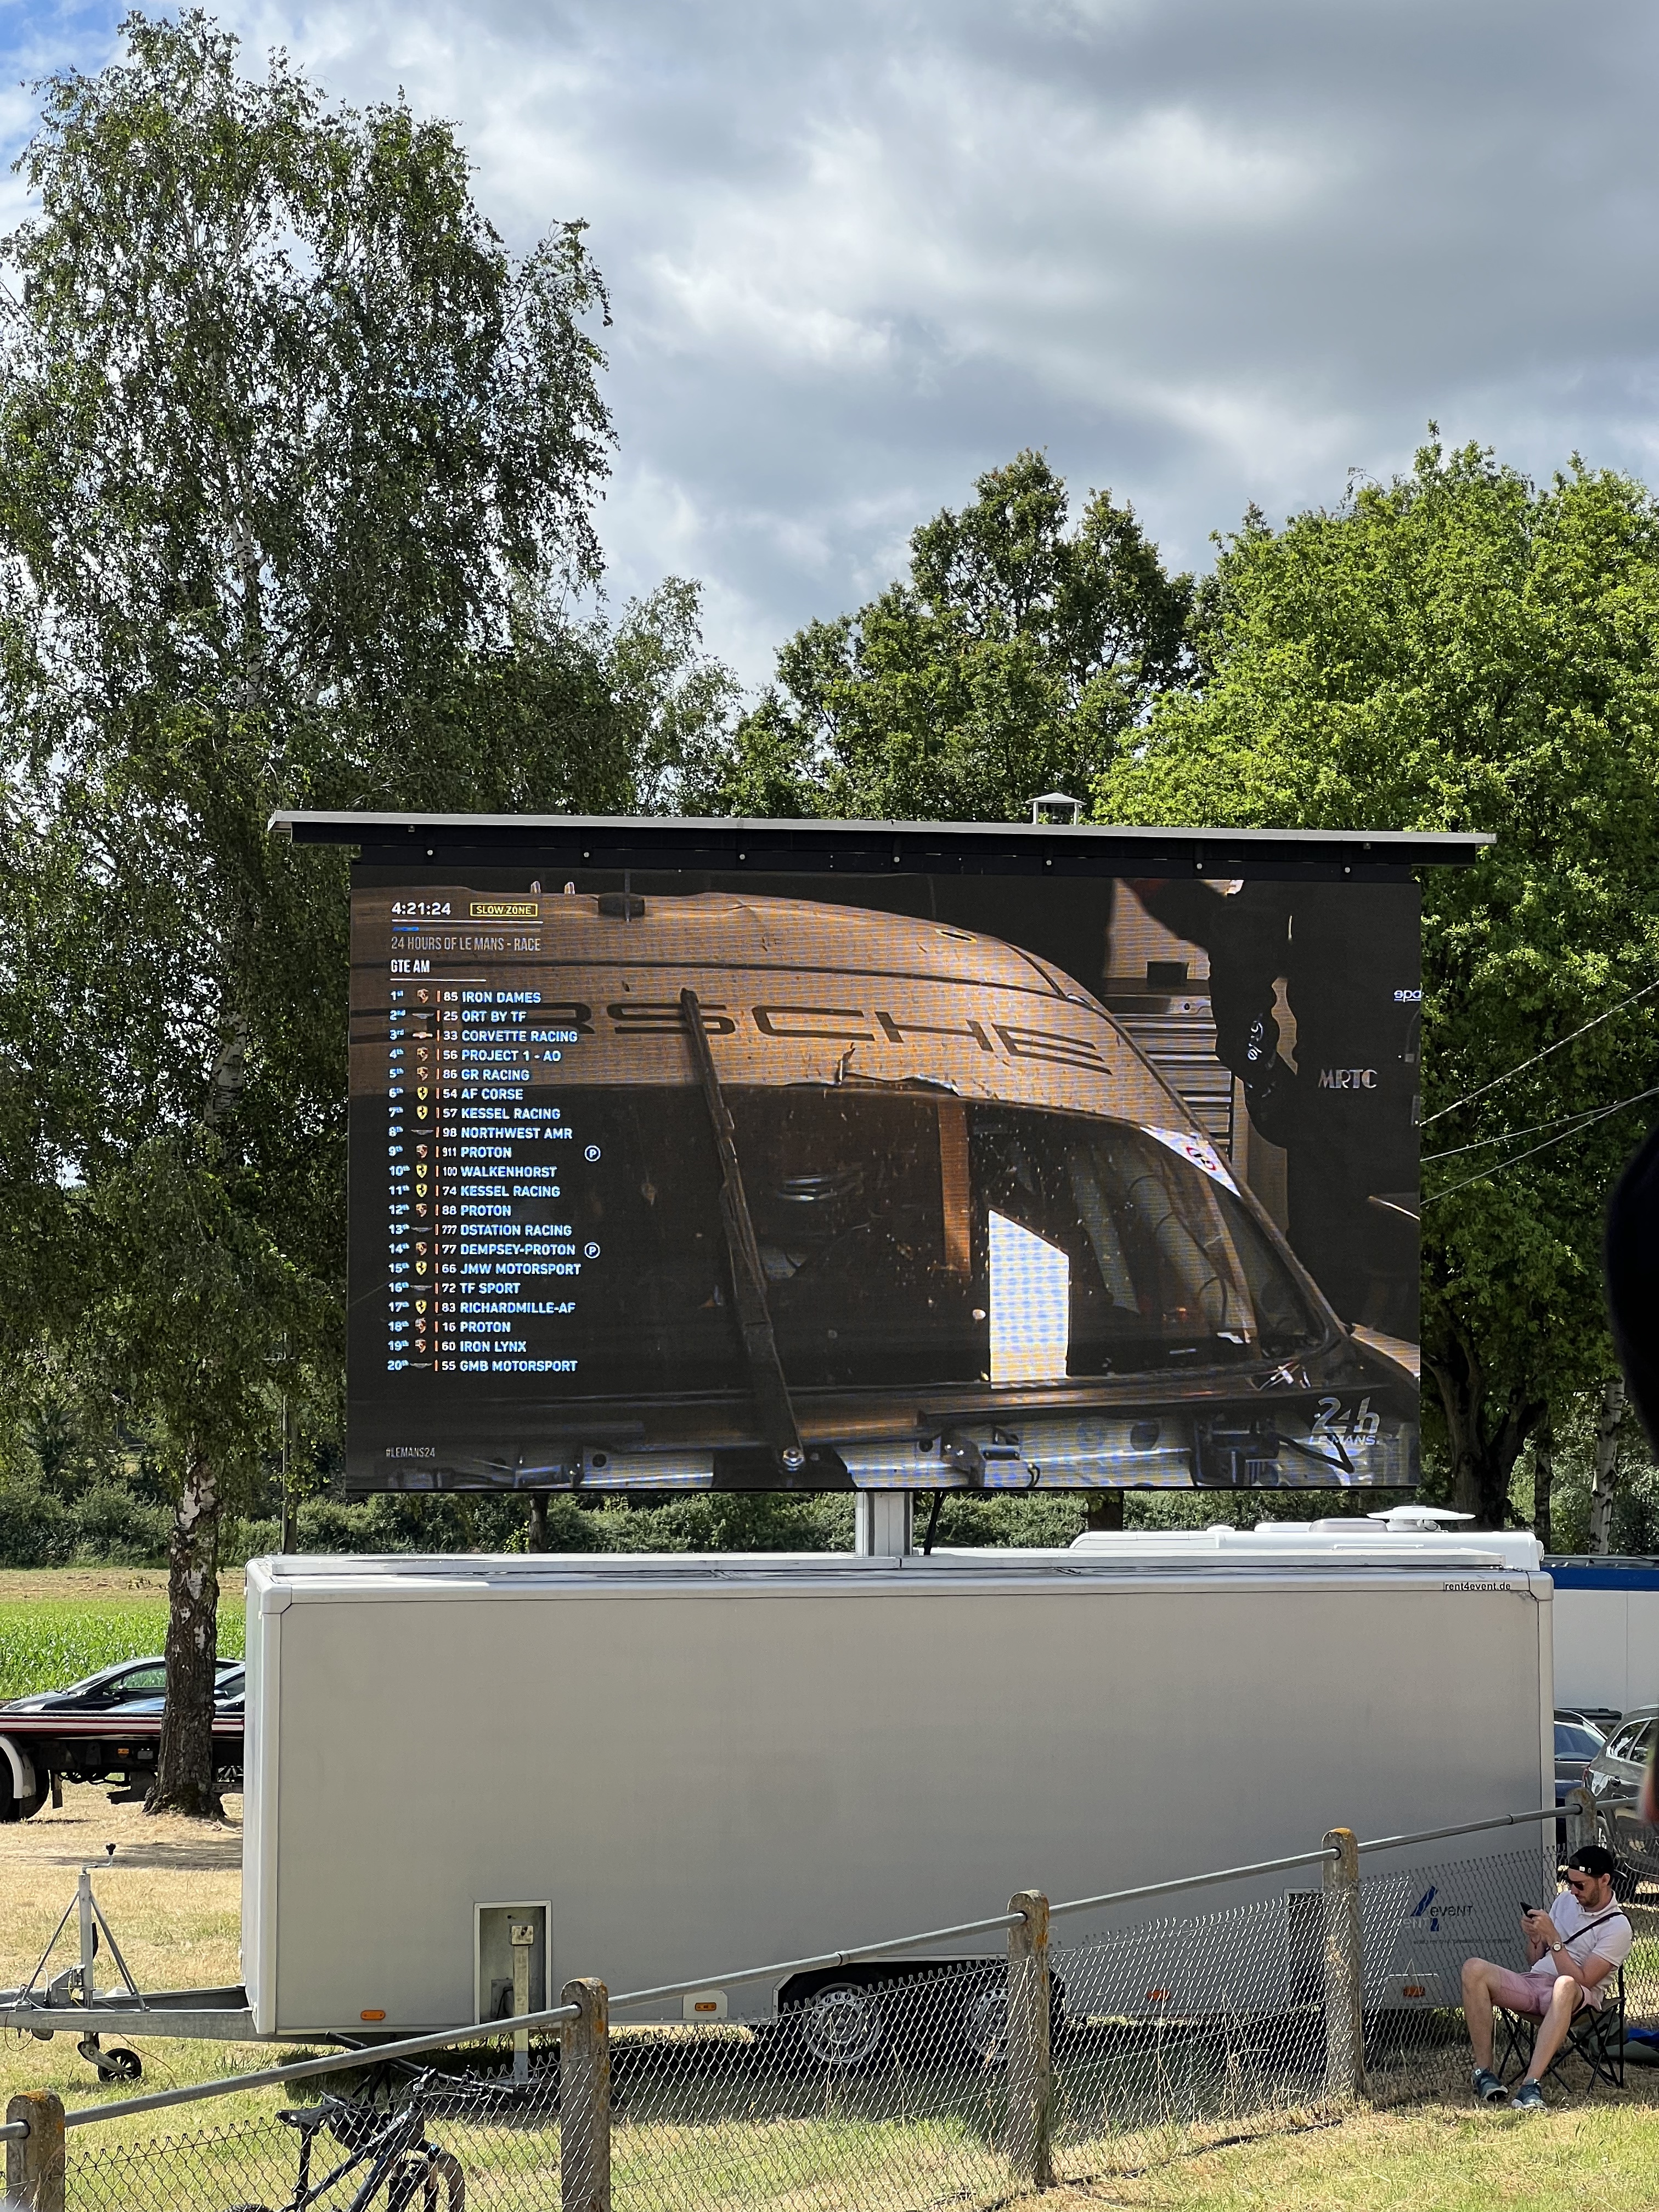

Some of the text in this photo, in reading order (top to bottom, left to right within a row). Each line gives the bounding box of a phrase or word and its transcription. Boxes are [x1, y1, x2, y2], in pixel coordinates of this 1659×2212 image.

[392, 902, 451, 915] 4:21:24
[476, 905, 532, 915] SLOW ZONE
[391, 936, 404, 950] 24
[408, 936, 442, 951] HOURS
[444, 937, 458, 951] OF
[460, 937, 472, 951] LE
[474, 938, 504, 951] MANS
[514, 938, 541, 952] RACE
[390, 959, 430, 973] GTE AM
[443, 991, 459, 1001] 85
[462, 991, 493, 1003] IRON
[496, 991, 541, 1003] DAMES
[443, 1011, 458, 1021] 25
[461, 1010, 487, 1022] ORT
[490, 1010, 507, 1023] BY
[510, 1011, 527, 1022] TF
[443, 1030, 458, 1041] 33
[461, 1030, 527, 1042] CORVETTE
[530, 1030, 578, 1043] RACING
[443, 1049, 458, 1060] 56
[461, 1049, 519, 1061] PROJECT
[523, 1050, 530, 1061] 1
[543, 1050, 561, 1062] AO
[442, 1069, 458, 1079] 86
[461, 1068, 479, 1080] GR
[482, 1069, 530, 1081] RACING
[1317, 1068, 1378, 1089] MRTC
[443, 1088, 458, 1099] 54
[461, 1088, 478, 1099] AF
[481, 1088, 523, 1101] CORSE
[443, 1108, 458, 1118] 57
[461, 1107, 510, 1120] KESSEL
[514, 1108, 561, 1120] RACING
[443, 1127, 458, 1137] 98
[461, 1127, 541, 1139] NORTHWEST
[544, 1127, 573, 1139] AMR
[442, 1147, 456, 1157] 911
[460, 1146, 512, 1158] PROTON
[443, 1166, 458, 1177] 100
[460, 1166, 557, 1178] WALKENHORST
[442, 1186, 457, 1196] 74
[460, 1185, 510, 1197] KESSEL
[512, 1186, 561, 1197] RACING
[442, 1205, 457, 1215] 88
[460, 1204, 511, 1216] PROTON
[442, 1224, 457, 1235] 777
[460, 1224, 521, 1236] DSTATION
[524, 1224, 572, 1237] RACING
[442, 1244, 456, 1254] 77
[460, 1243, 575, 1256] DEMPSEY-PROTON
[442, 1263, 457, 1274] 66
[460, 1263, 492, 1274] JMW
[495, 1263, 582, 1275] MOTORSPORT
[442, 1283, 456, 1293] 72
[459, 1283, 476, 1294] TF
[478, 1282, 521, 1294] SPORT
[442, 1302, 456, 1312] 83
[460, 1301, 576, 1314] RICHARDMILLE-AF
[442, 1322, 456, 1332] 16
[460, 1321, 511, 1333] PROTON
[442, 1341, 456, 1351] 60
[460, 1341, 490, 1352] IRON
[494, 1341, 527, 1352] LYNX
[442, 1361, 456, 1370] 55
[459, 1359, 489, 1372] GMB
[492, 1360, 578, 1372] MOTORSPORT
[1444, 1582, 1511, 1590] rent4event.de
